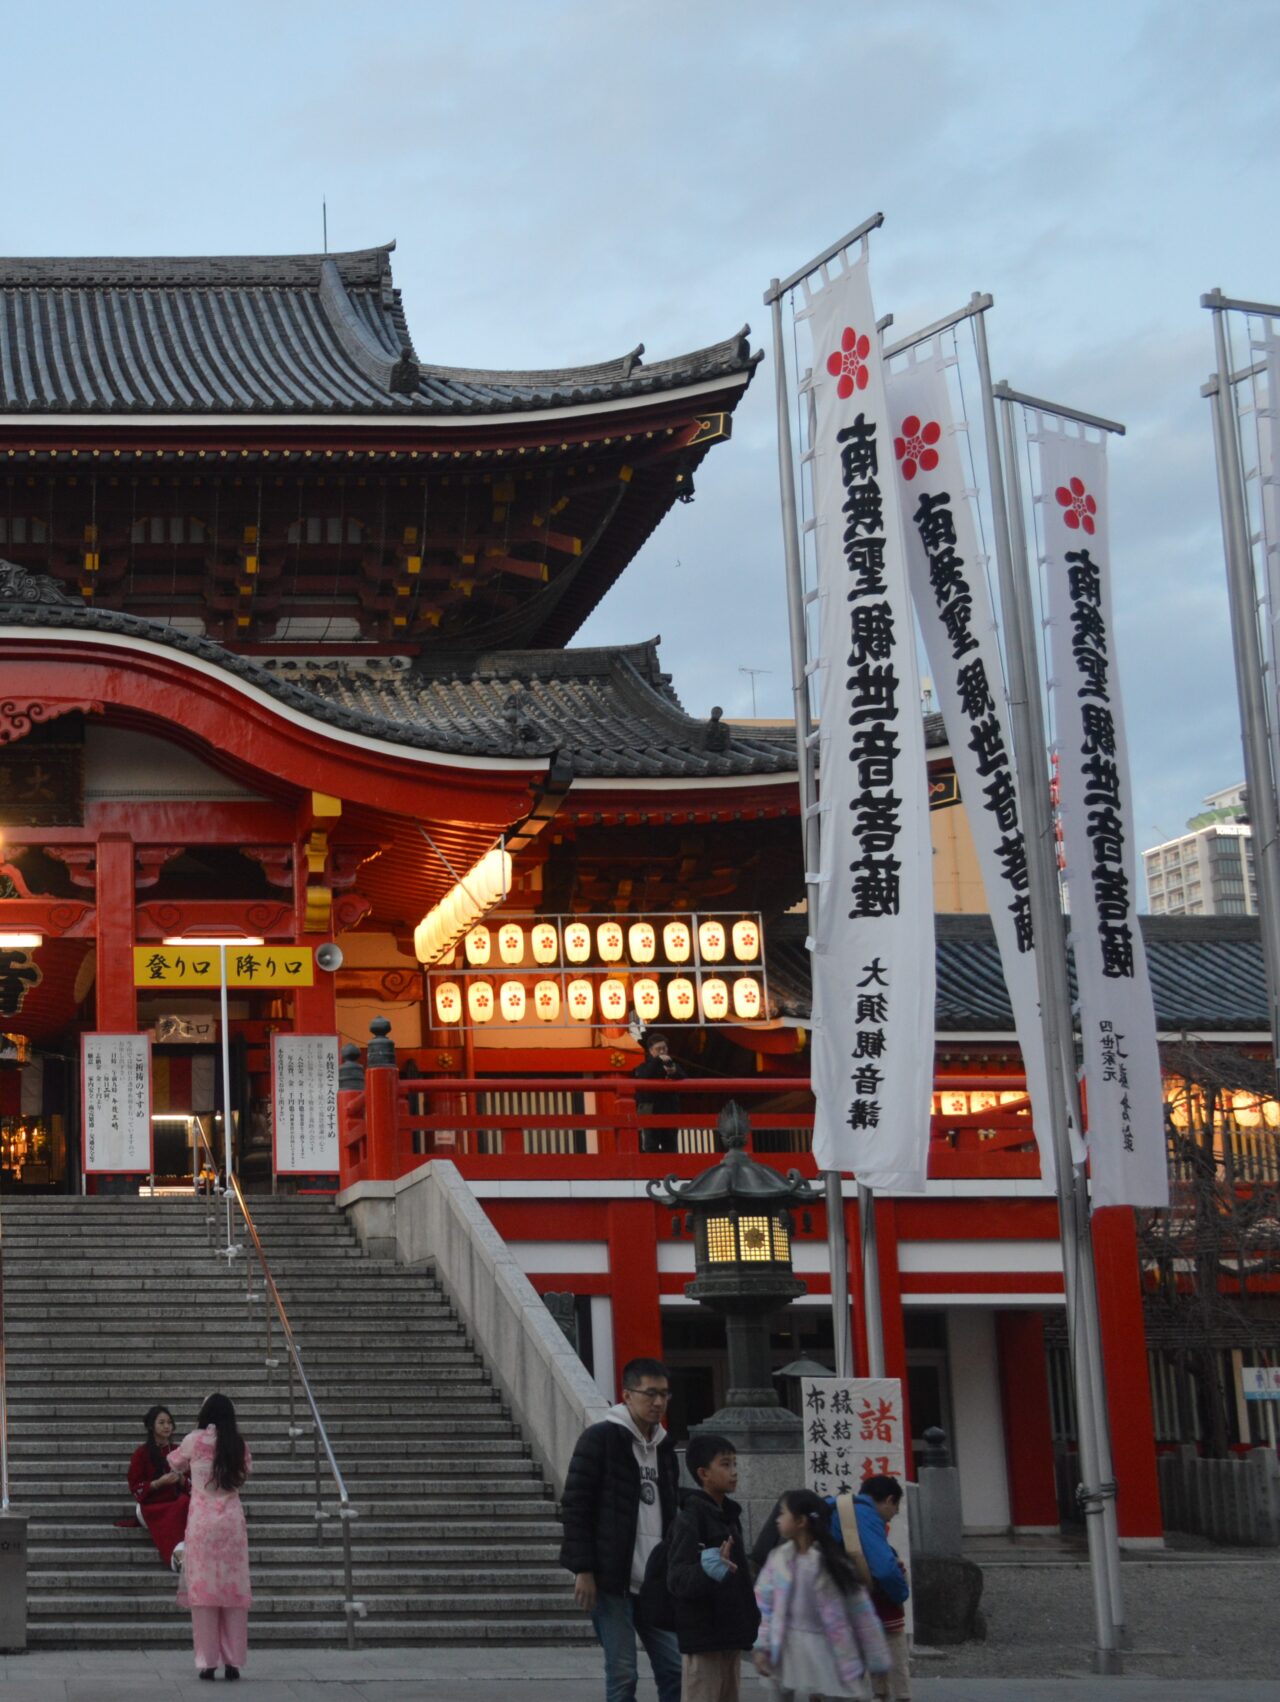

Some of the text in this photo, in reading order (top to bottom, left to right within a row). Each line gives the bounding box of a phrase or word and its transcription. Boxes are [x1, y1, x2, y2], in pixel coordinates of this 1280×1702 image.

[144, 954, 210, 980] 登り口
[236, 955, 303, 981] 降り口
[806, 1384, 833, 1493] 布袋様に
